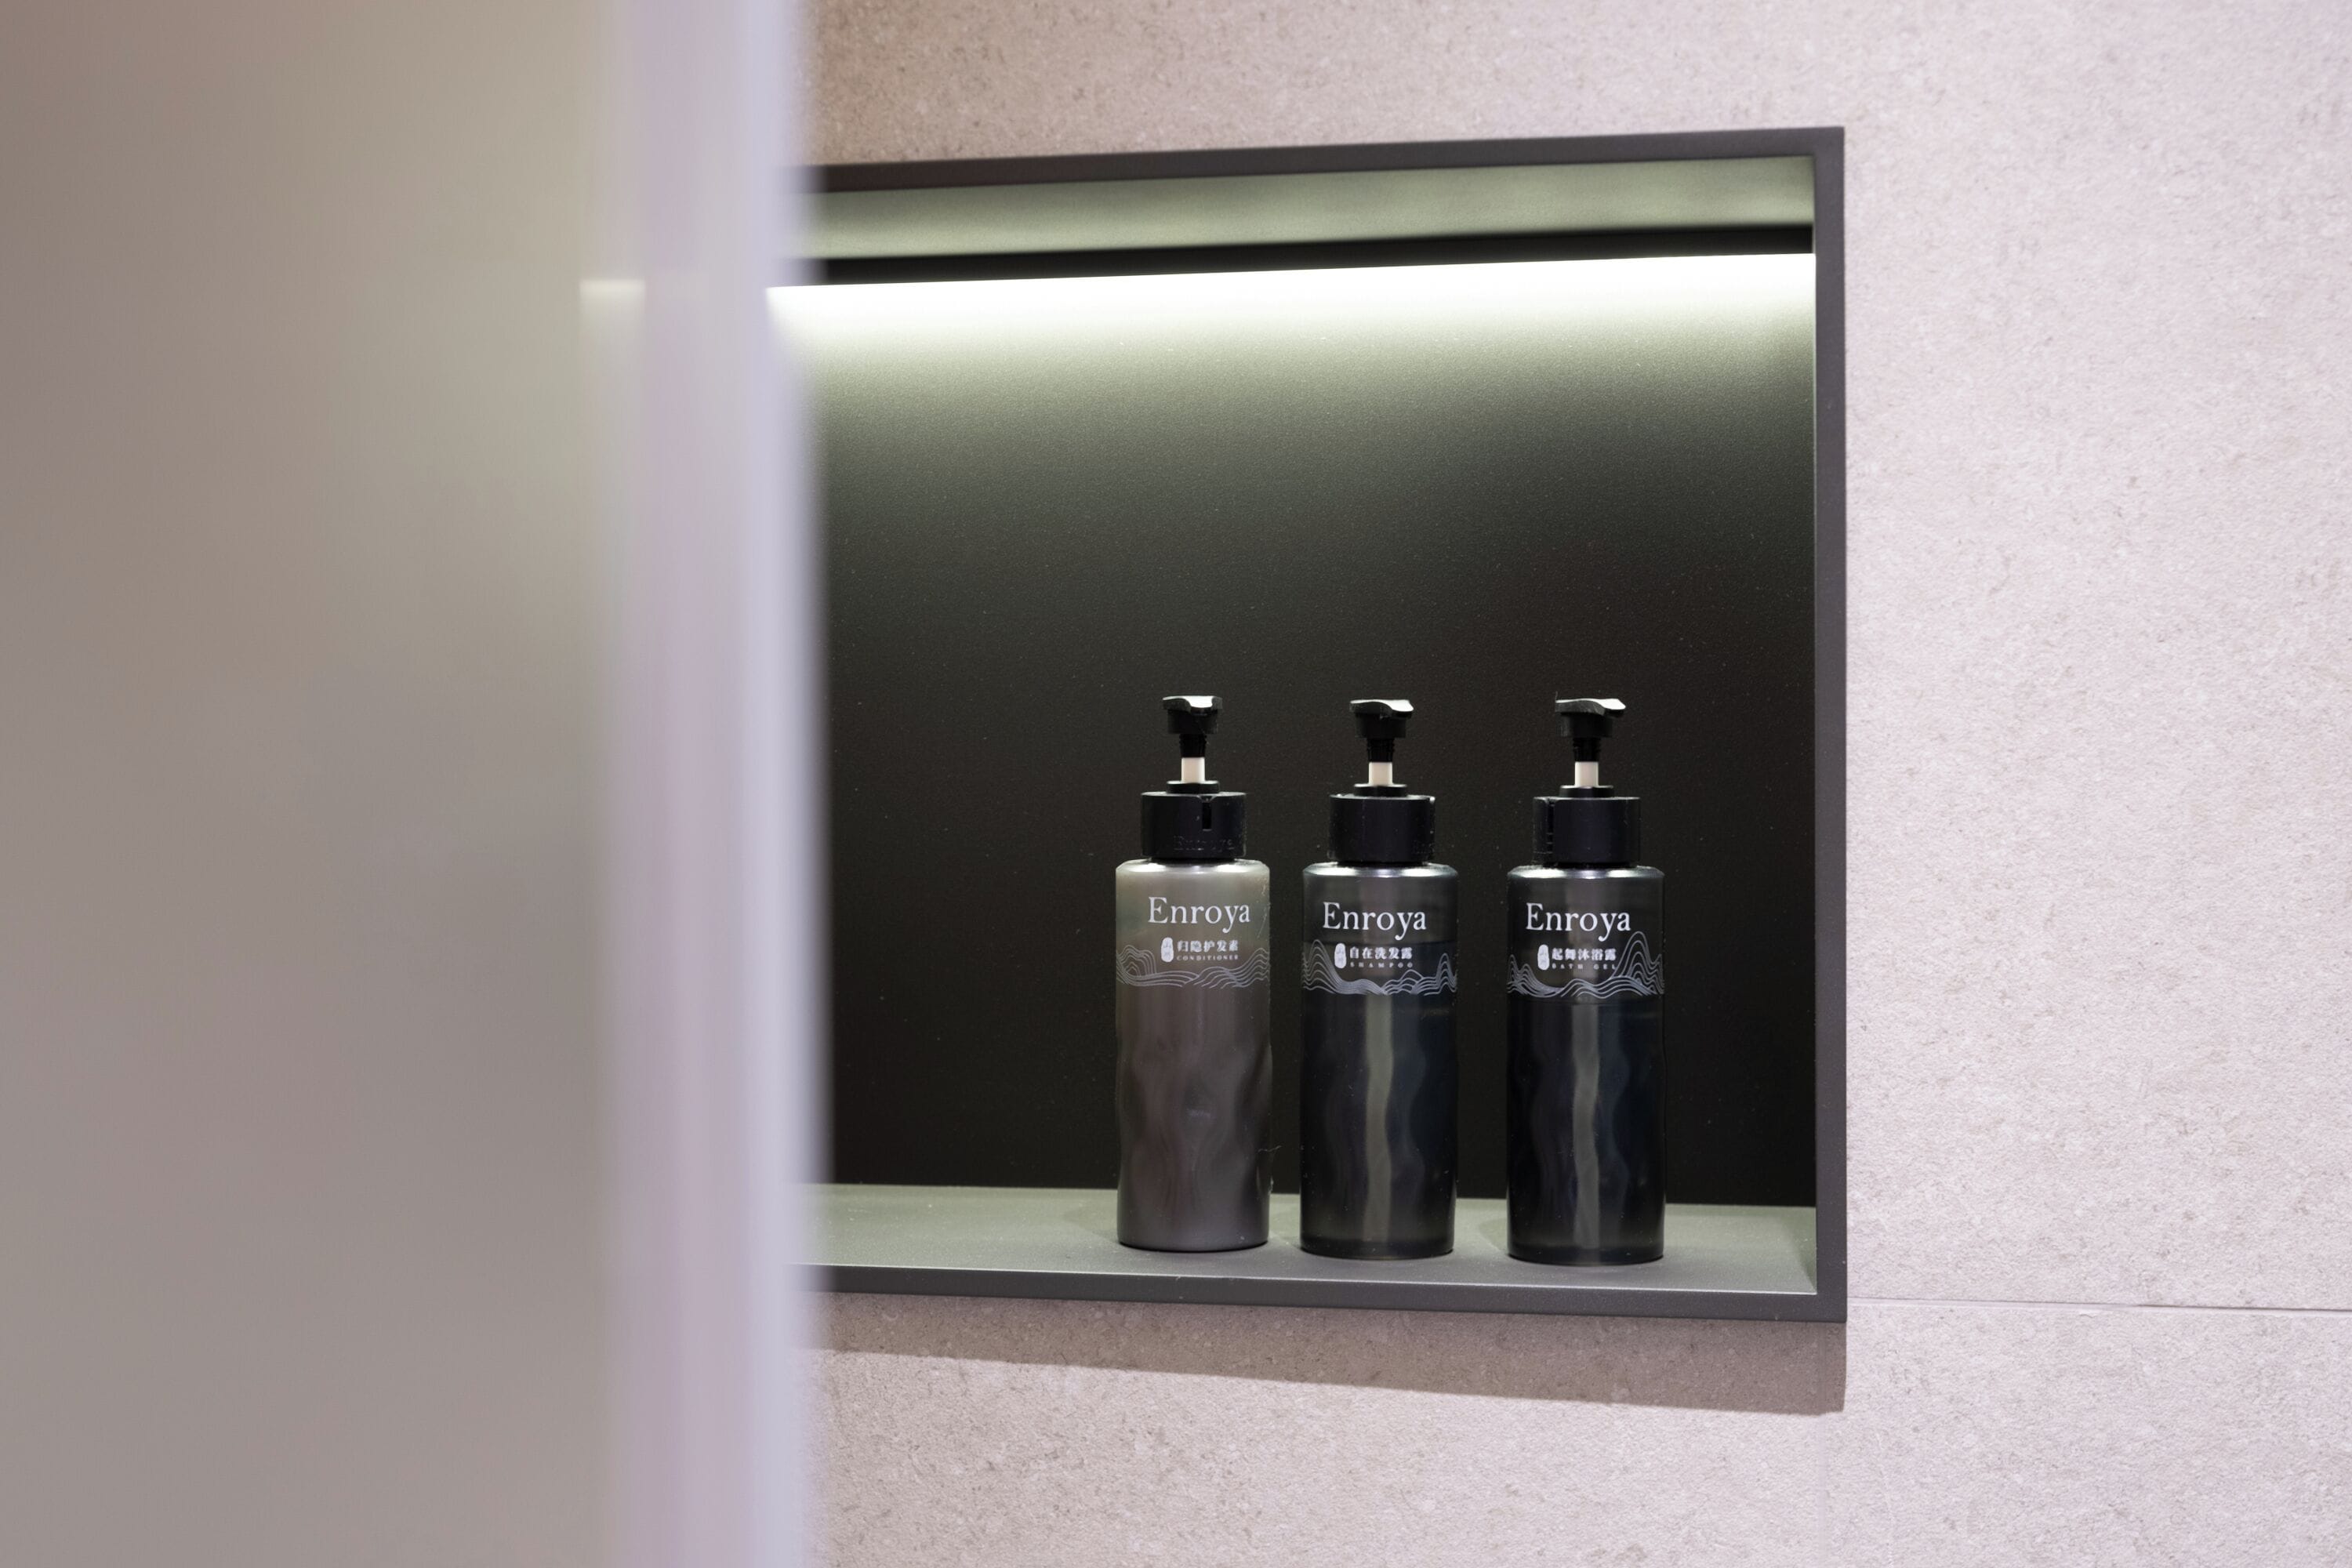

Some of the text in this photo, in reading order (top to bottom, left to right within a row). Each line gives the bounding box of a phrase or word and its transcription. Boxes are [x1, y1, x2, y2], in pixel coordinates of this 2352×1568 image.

[1148, 896, 1250, 934] Enroya
[1323, 901, 1427, 941] Enroya
[1526, 902, 1632, 942] Enroya
[1349, 946, 1413, 960] 自在洗发露
